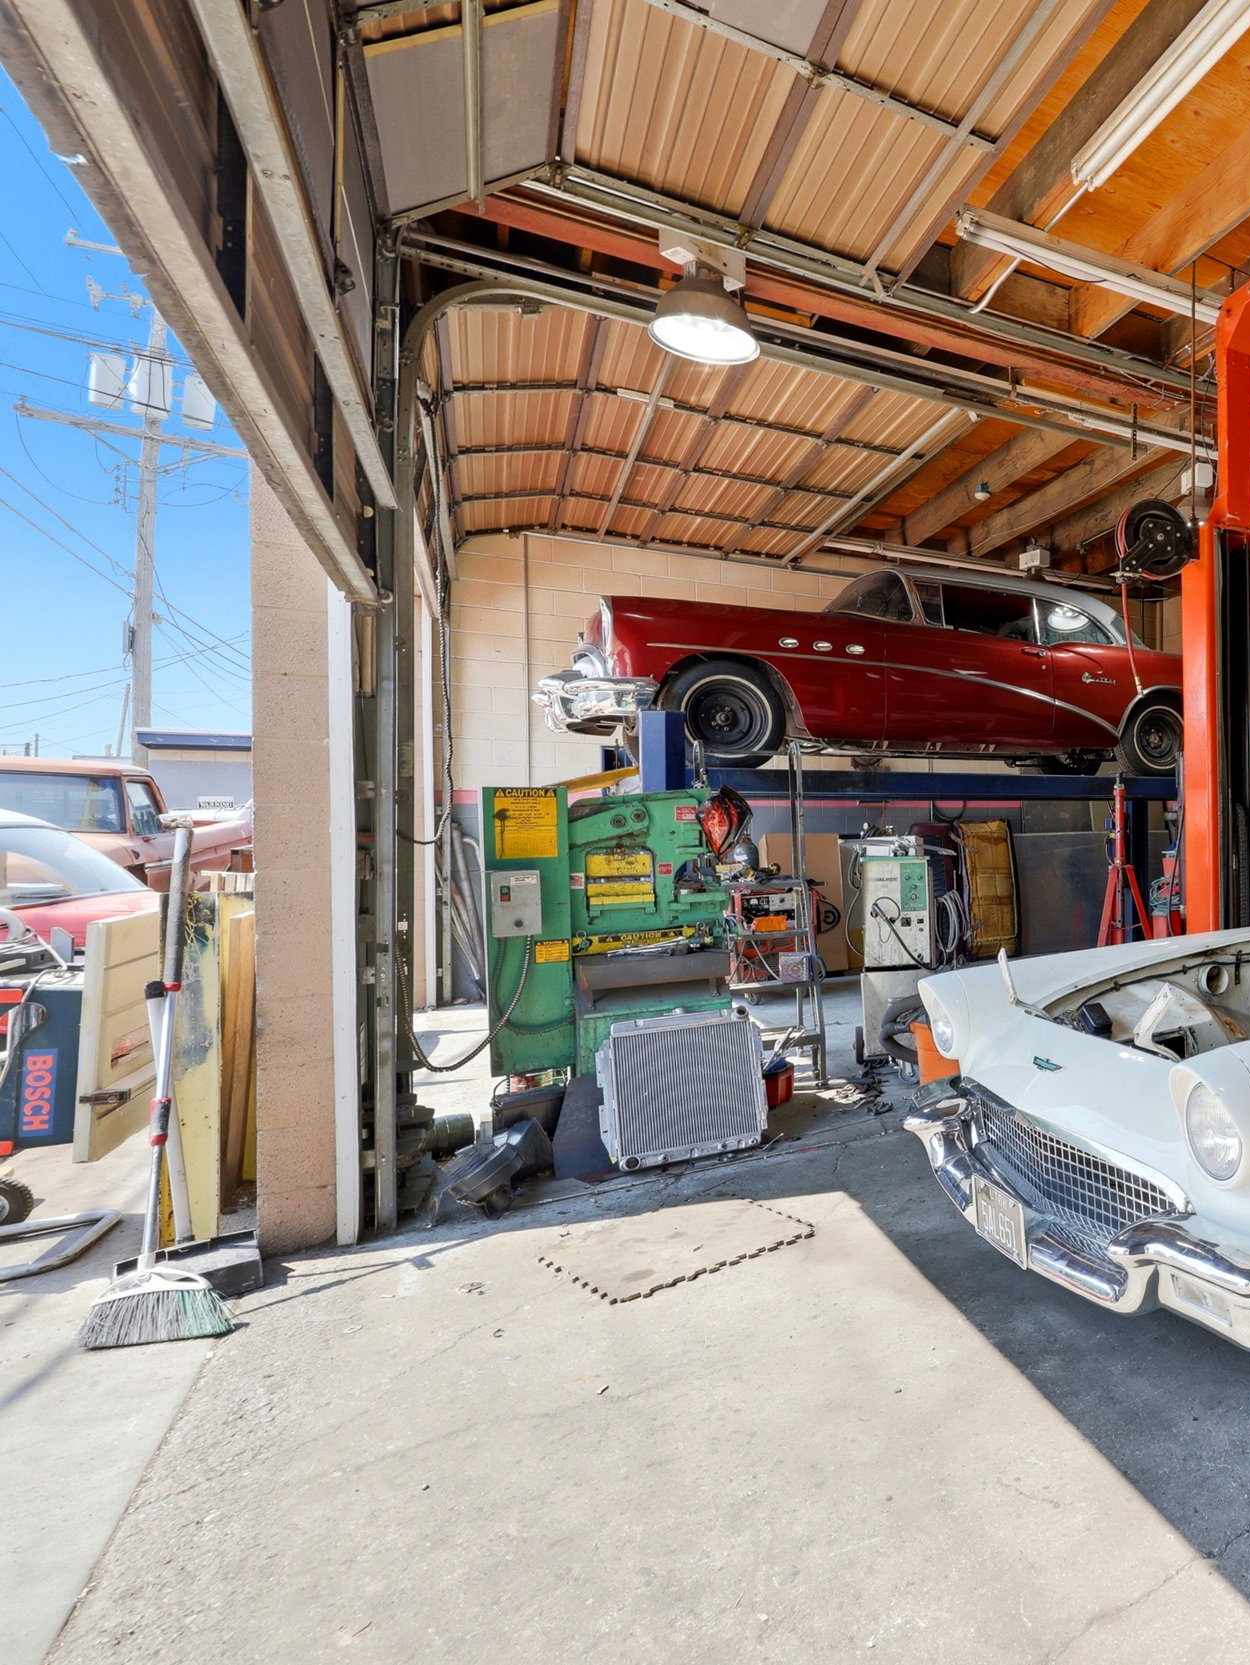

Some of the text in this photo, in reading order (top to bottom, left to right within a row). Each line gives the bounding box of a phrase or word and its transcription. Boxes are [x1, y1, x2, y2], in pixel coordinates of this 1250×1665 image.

[505, 788, 545, 797] CAUTION
[620, 931, 662, 941] CAUTION
[22, 1054, 54, 1131] BOSCH
